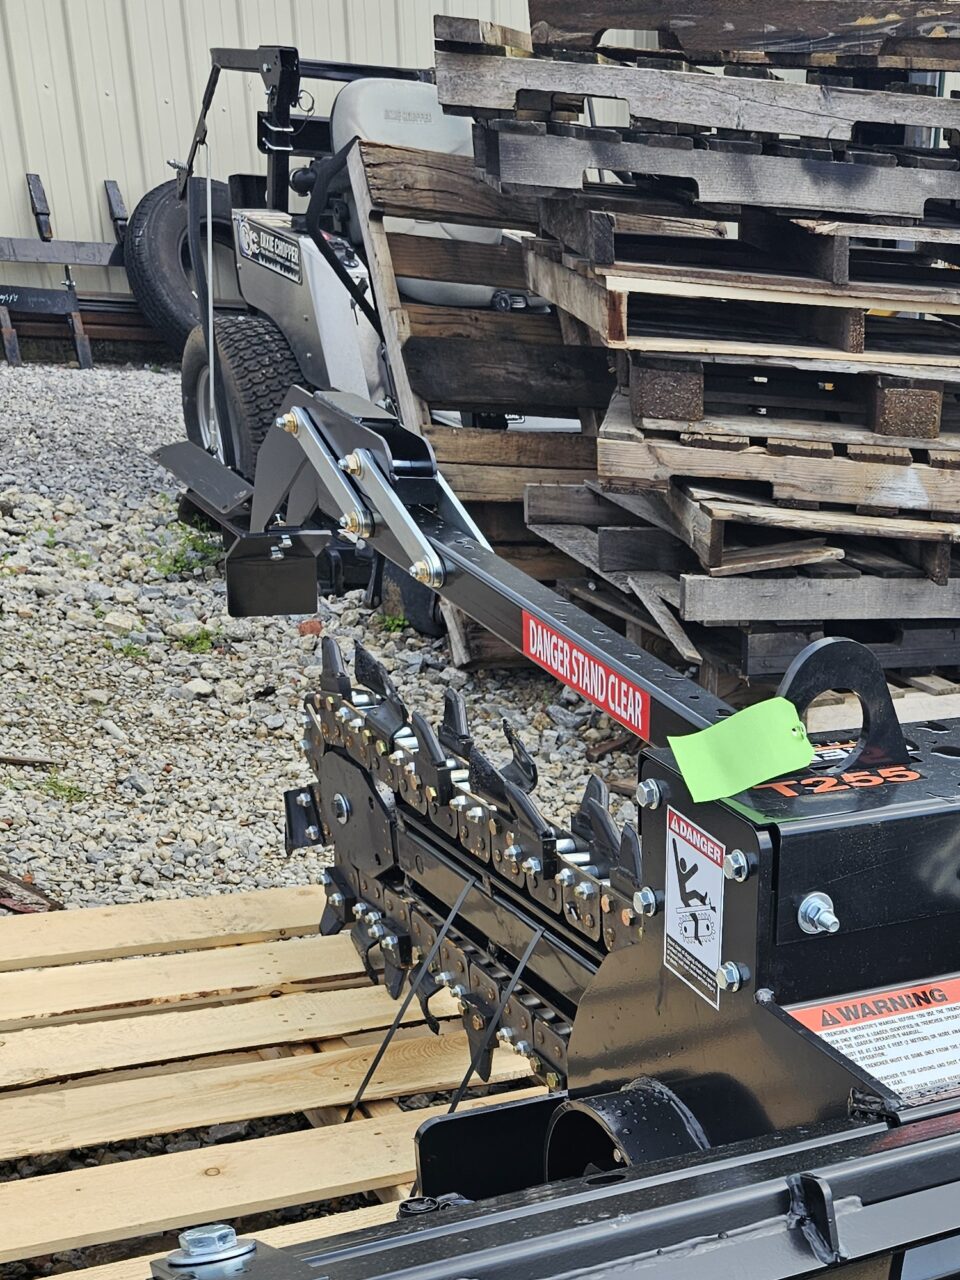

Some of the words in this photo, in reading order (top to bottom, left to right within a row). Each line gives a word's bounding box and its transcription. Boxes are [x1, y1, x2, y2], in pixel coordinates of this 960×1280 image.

[529, 619, 571, 680] DANGER
[571, 649, 606, 703] STAND
[608, 674, 643, 730] CLEAR
[753, 766, 921, 798] T255
[679, 820, 721, 865] DANGER
[836, 987, 949, 1022] WARNING
